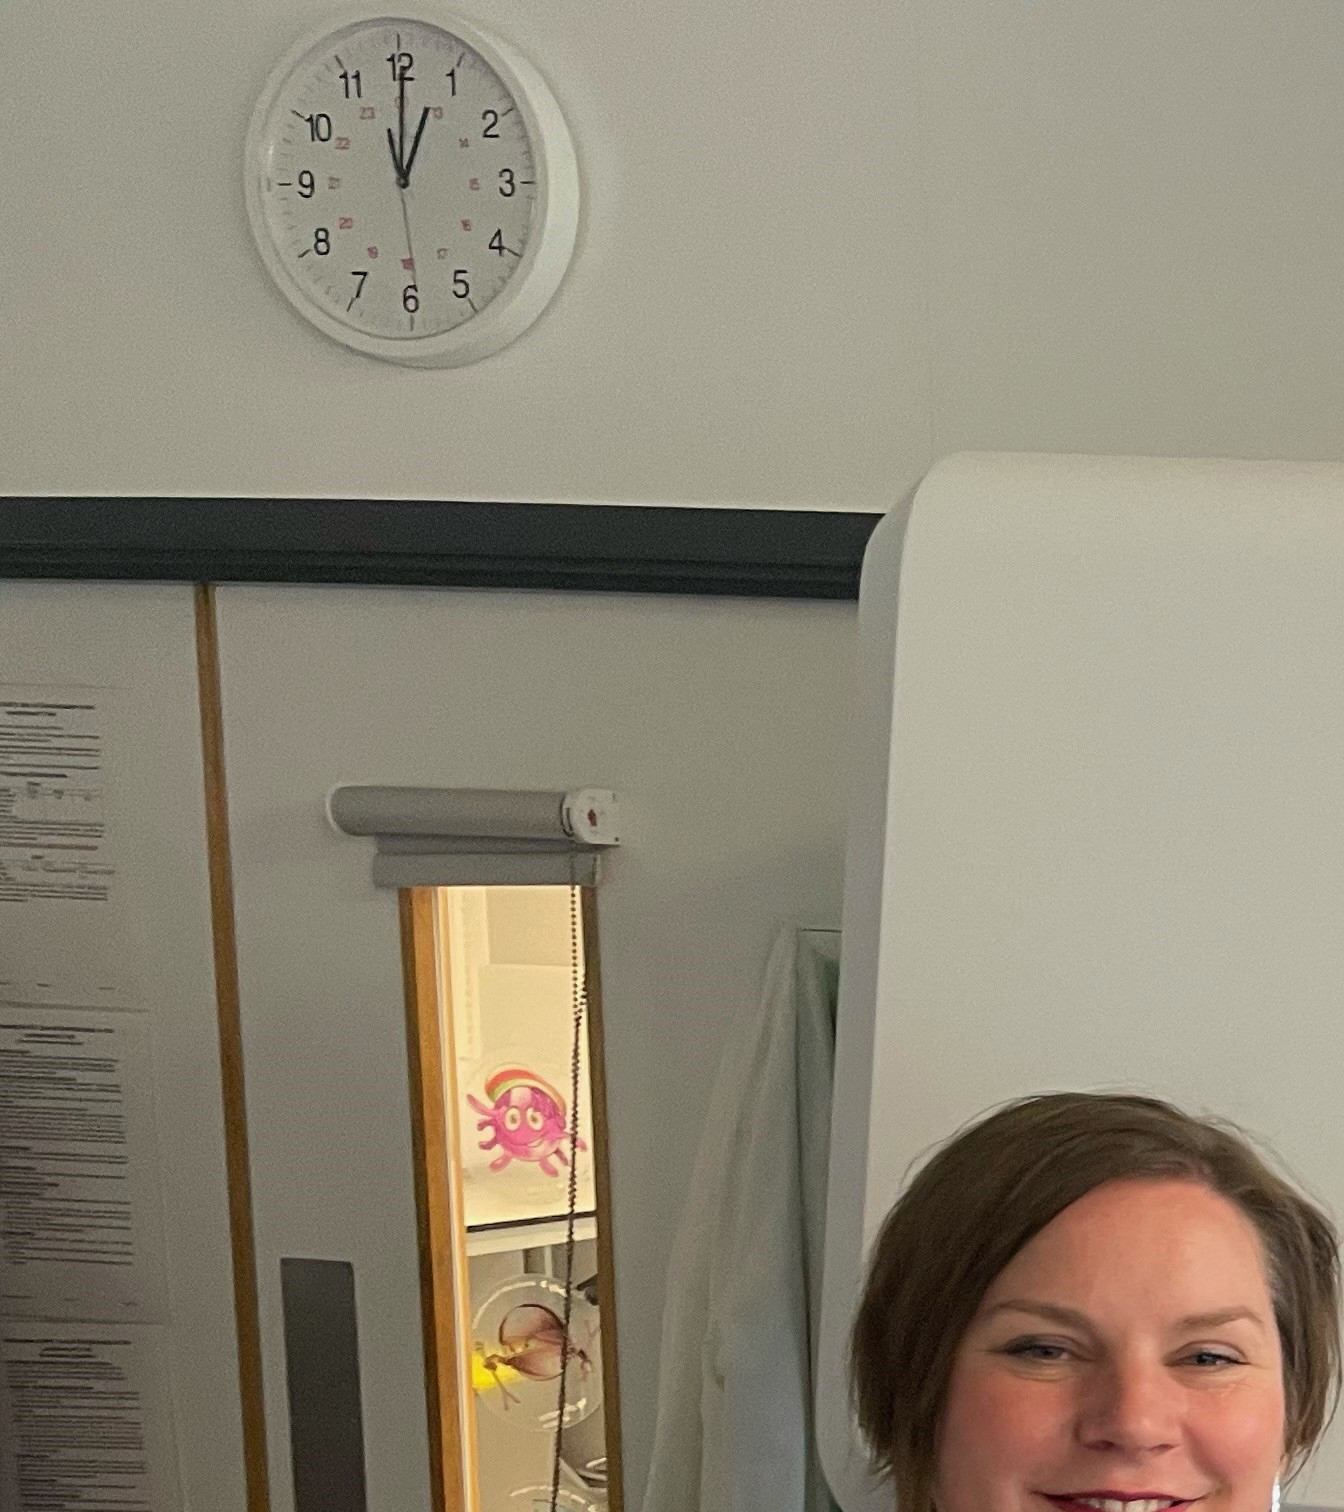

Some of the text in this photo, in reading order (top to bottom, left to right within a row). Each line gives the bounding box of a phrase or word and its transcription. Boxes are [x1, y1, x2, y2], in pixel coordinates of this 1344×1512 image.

[386, 52, 414, 82] 12
[339, 69, 362, 99] 11
[445, 68, 456, 97] 1
[304, 113, 332, 142] 10
[481, 109, 500, 139] 2
[297, 170, 315, 198] 9
[498, 168, 516, 198] 3
[313, 227, 331, 256] 8
[488, 228, 503, 257] 4
[351, 270, 369, 299] 7
[402, 284, 420, 313] 6
[452, 269, 470, 299] 5
